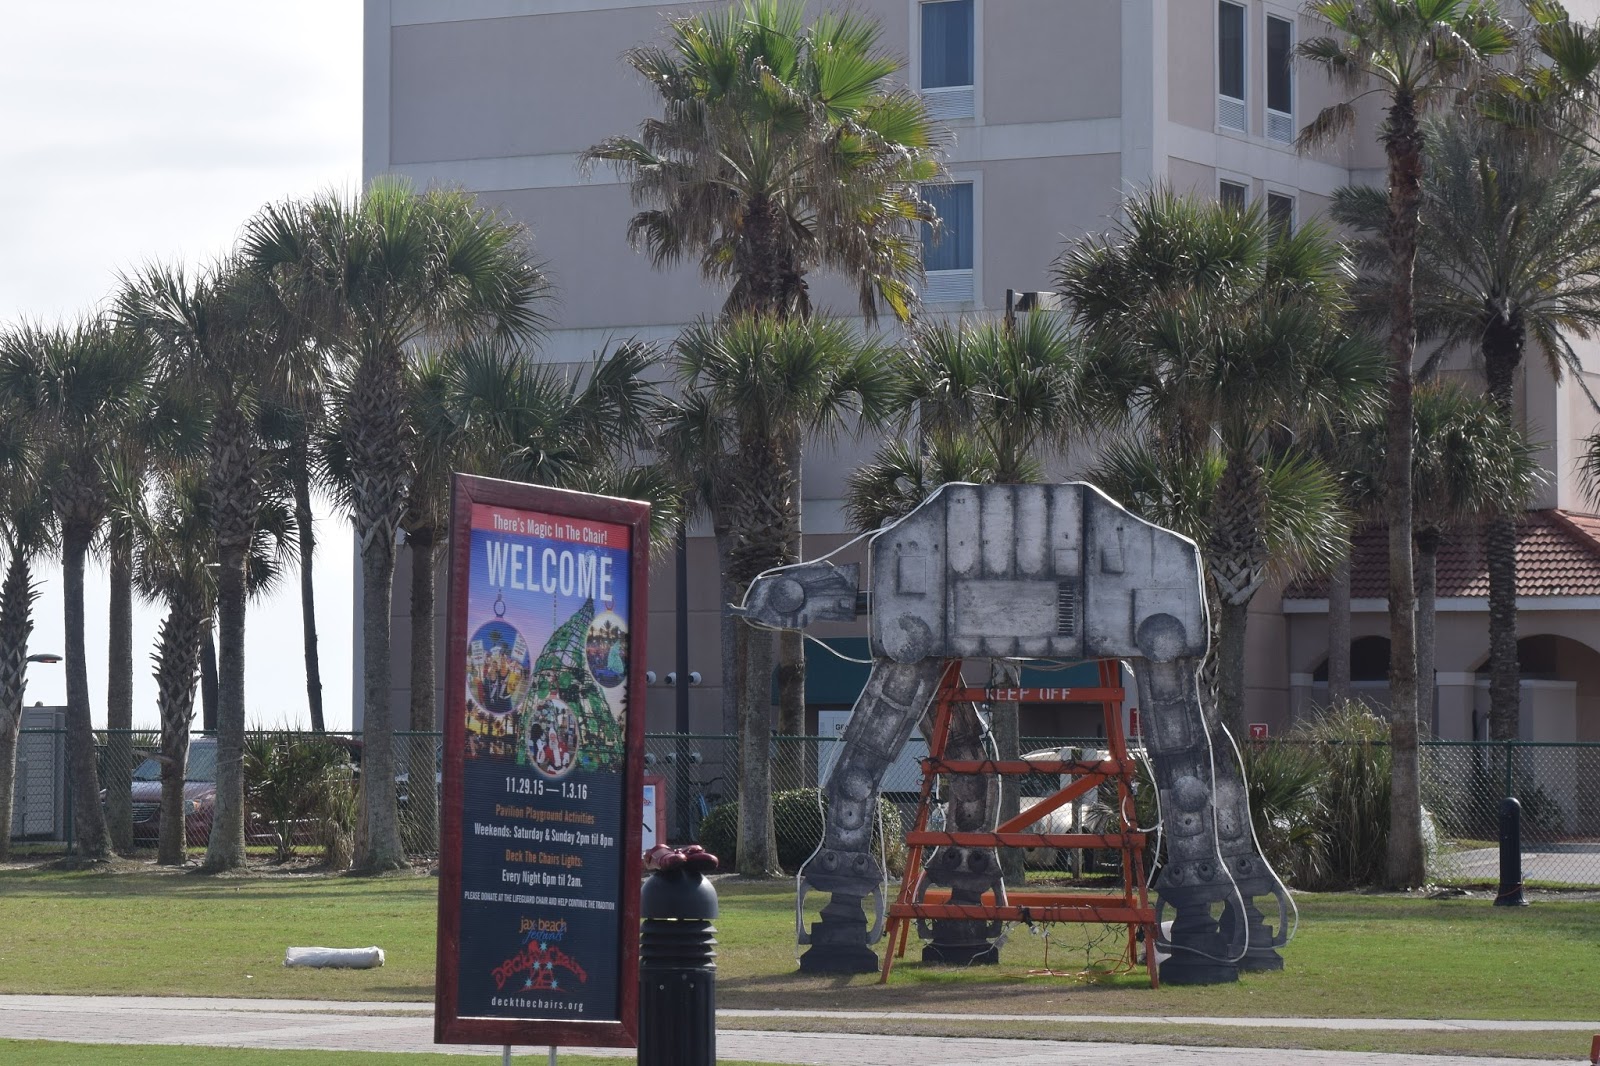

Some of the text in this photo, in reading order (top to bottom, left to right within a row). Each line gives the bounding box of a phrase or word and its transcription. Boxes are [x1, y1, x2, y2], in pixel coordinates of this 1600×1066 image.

[494, 514, 608, 545] There's Magic In The Chair!
[486, 540, 613, 602] WELCOME
[986, 688, 1071, 701] KEEP OFF
[506, 777, 544, 795] 11.29.15
[562, 782, 587, 800] 1.3.16
[495, 804, 524, 818] Pavilion
[525, 806, 562, 822] Playground
[474, 823, 614, 847] Weekends: Saturday & Sunday 2pm til 8pm
[505, 849, 583, 868] Deck The Chairs Lights:
[502, 869, 583, 888] Every Night 6pm til 2am.
[464, 891, 480, 900] PLEASE
[480, 892, 497, 902] DONATE
[498, 893, 504, 902] AT
[504, 894, 512, 902] THE
[512, 894, 535, 904] LIFEGUARD
[535, 896, 548, 905] CHAIR
[548, 897, 557, 906] AND
[557, 898, 568, 907] HELP
[568, 899, 587, 908] CONTINUE
[587, 900, 595, 909] THE
[519, 916, 567, 933] jax beach
[491, 996, 584, 1013] deckthechairs.org
